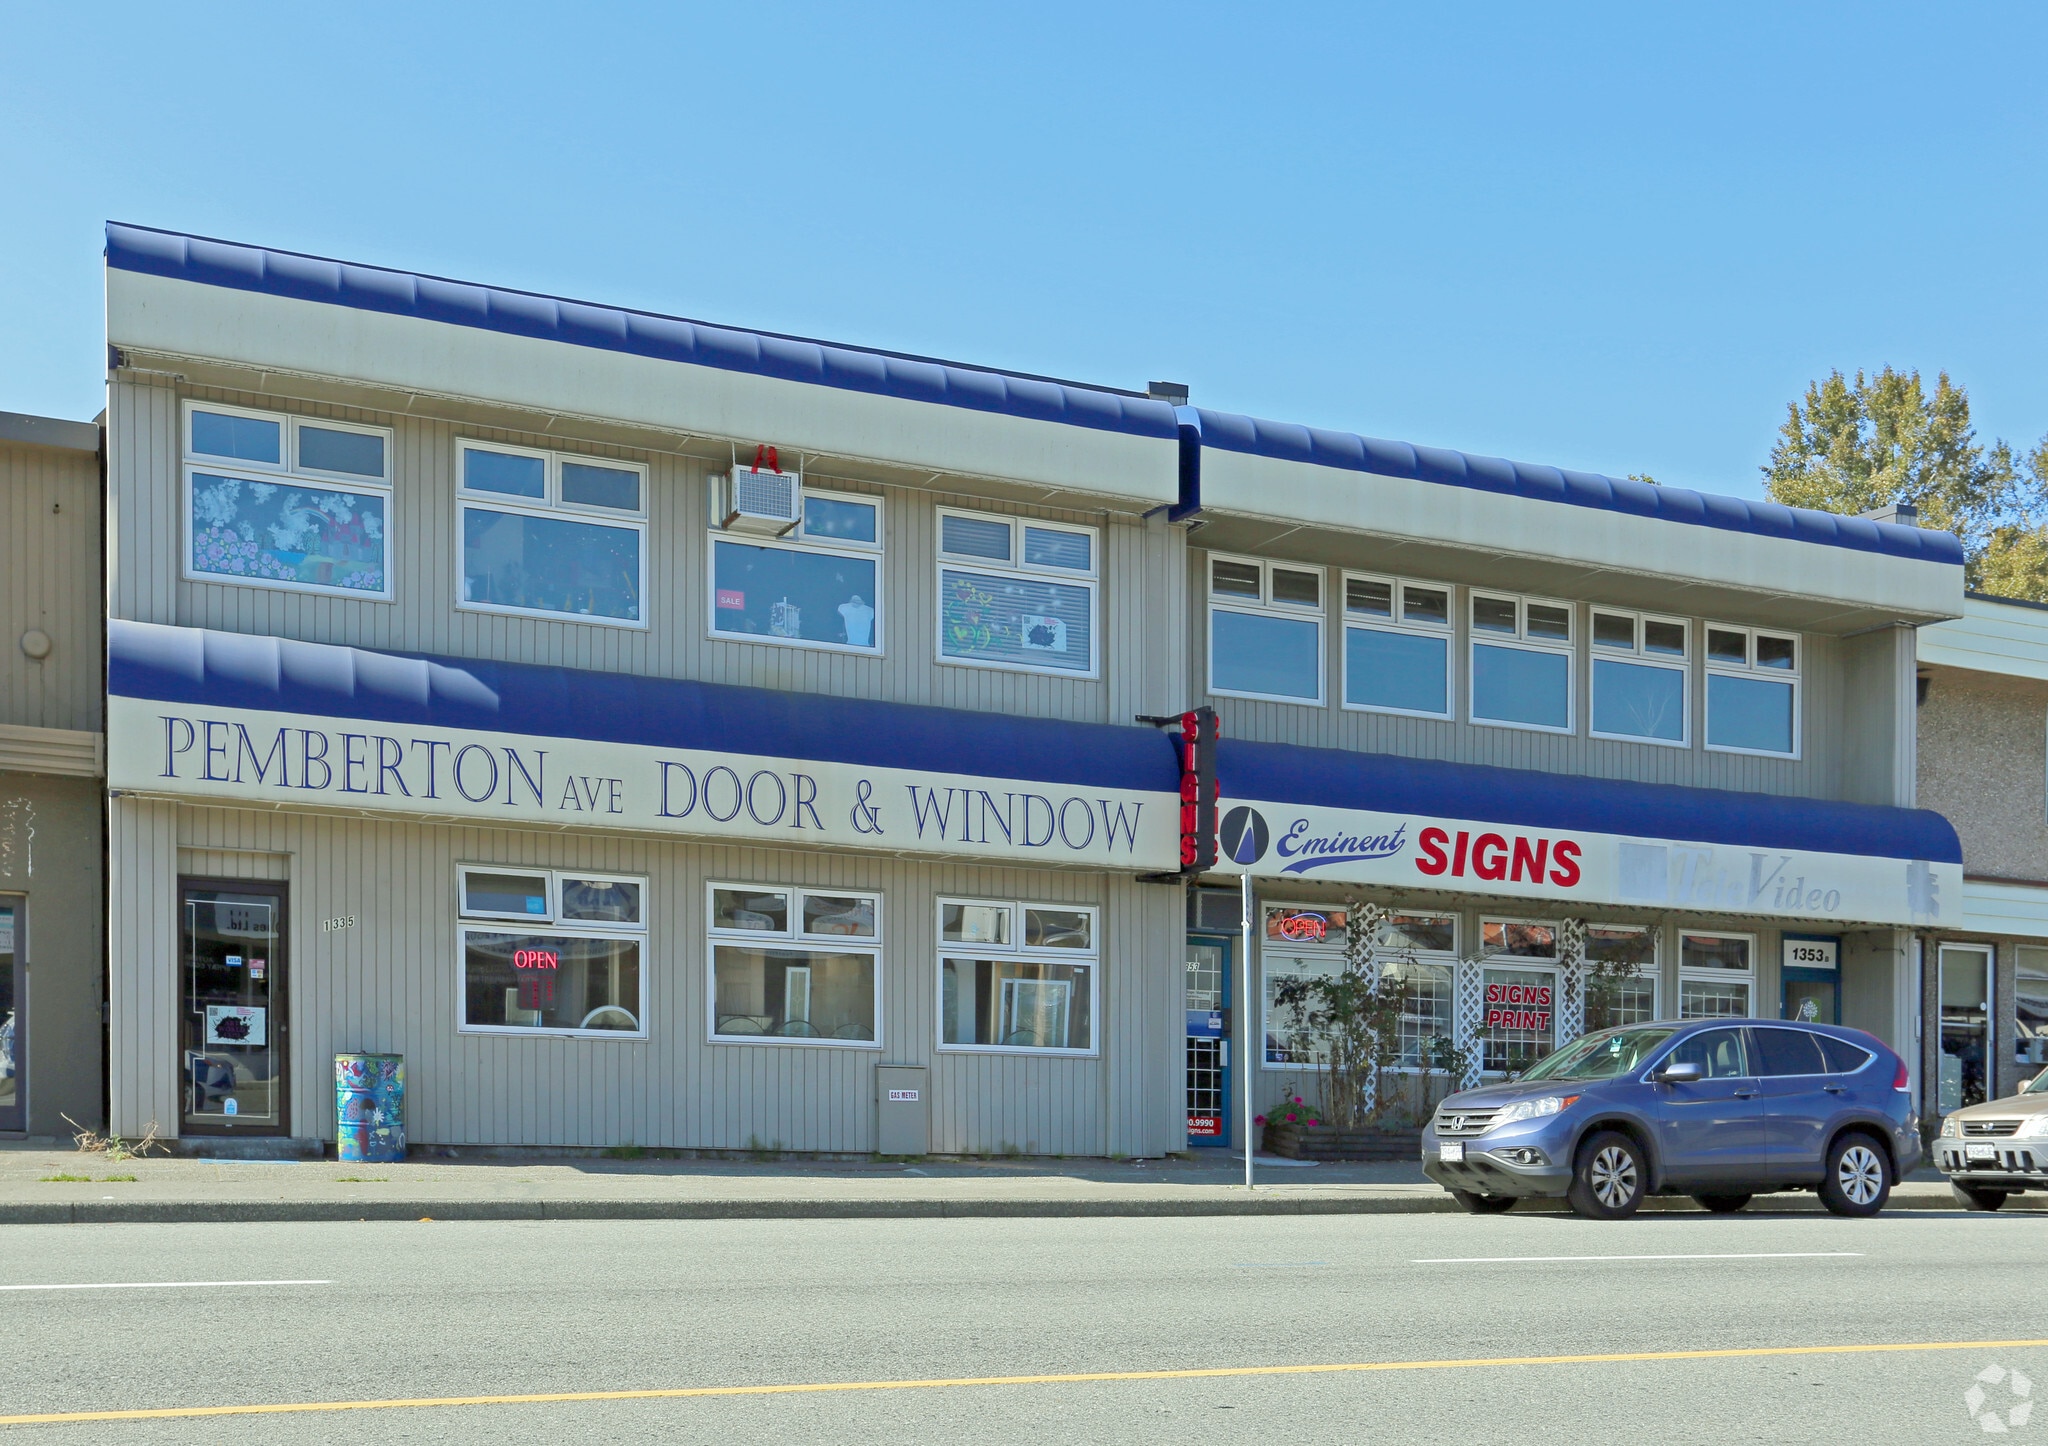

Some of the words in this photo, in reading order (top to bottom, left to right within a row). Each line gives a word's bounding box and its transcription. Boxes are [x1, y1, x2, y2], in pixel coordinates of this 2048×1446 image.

[721, 597, 740, 605] SALE
[158, 716, 549, 808] PEMBERTON
[559, 775, 623, 814] AVE
[655, 761, 825, 831] DOOR
[850, 779, 884, 836] &
[905, 785, 1144, 855] WINDOW
[1180, 711, 1199, 865] SIGNS
[1276, 818, 1406, 859] Eminent
[1415, 826, 1582, 888] SIGNS
[324, 916, 354, 931] 1335
[1281, 917, 1327, 938] OPEN
[514, 950, 559, 969] OPEN
[1792, 948, 1824, 962] 1353
[1487, 984, 1551, 1006] SIGNS
[1488, 1010, 1550, 1030] PRINT
[890, 1091, 900, 1099] GAS
[901, 1091, 917, 1099] METER
